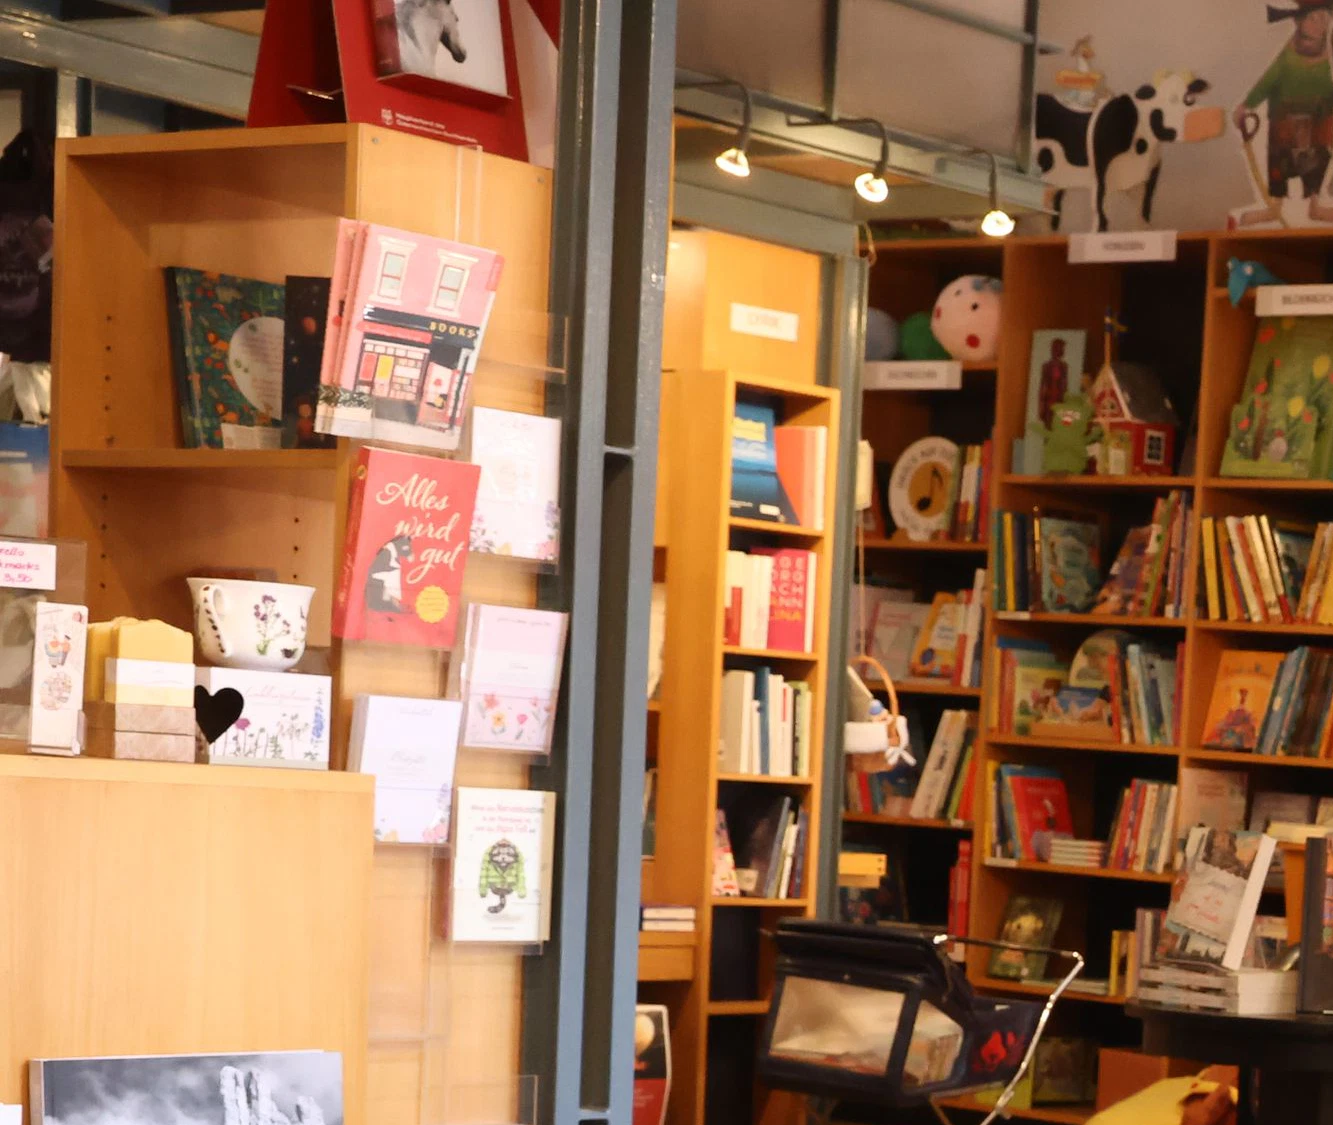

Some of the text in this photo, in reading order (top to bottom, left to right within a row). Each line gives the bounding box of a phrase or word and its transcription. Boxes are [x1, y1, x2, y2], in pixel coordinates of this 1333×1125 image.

[376, 473, 450, 512] Alles
[394, 512, 461, 542] wird
[406, 543, 466, 585] gut
